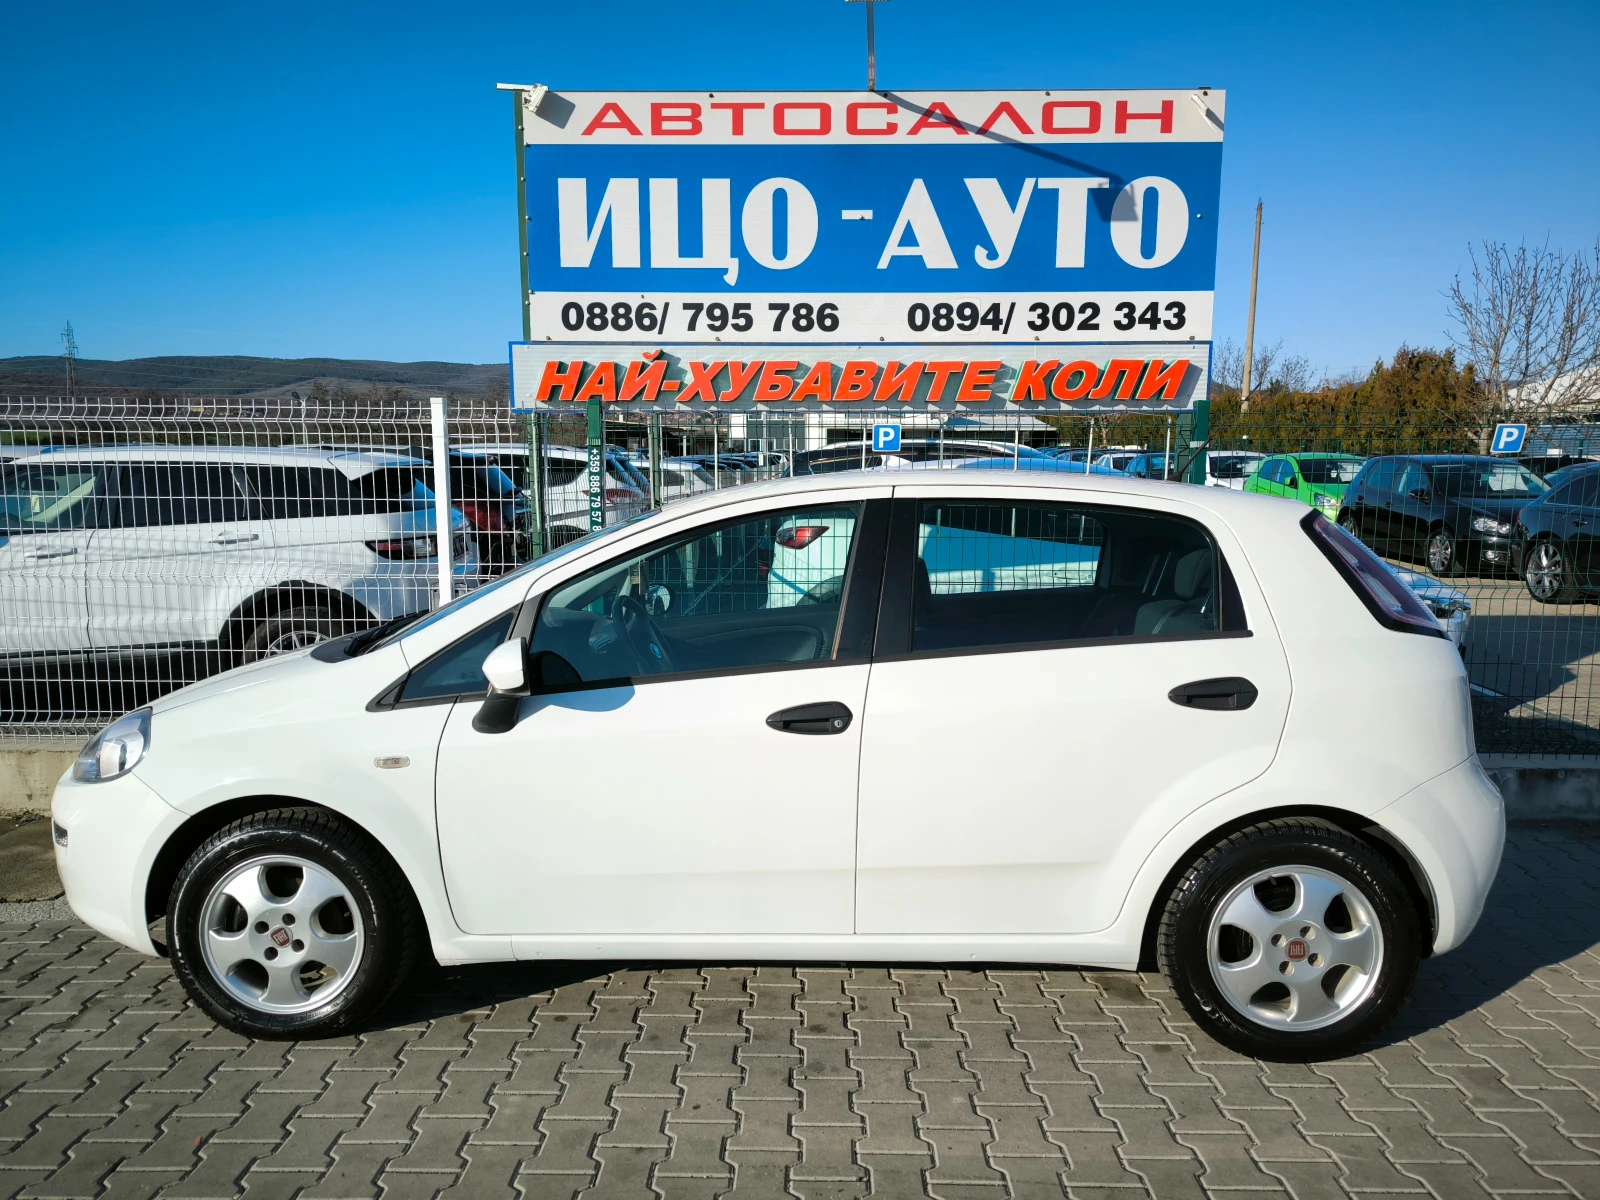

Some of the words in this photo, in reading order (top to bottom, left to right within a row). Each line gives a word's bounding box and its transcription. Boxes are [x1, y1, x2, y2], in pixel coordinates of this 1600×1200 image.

[581, 99, 1175, 138] АВТОСАЛОН
[561, 301, 670, 335] 0886/
[683, 302, 754, 332] 795
[768, 302, 840, 332] 786
[907, 301, 1016, 335] 0894/
[1027, 301, 1101, 332] 302
[1113, 301, 1187, 332] 343
[535, 349, 1003, 402] НАЙ-ХУБАВИТЕ
[1009, 358, 1191, 402] КОЛИ
[878, 427, 895, 448] P
[1498, 427, 1519, 449] P
[589, 448, 600, 472] +359
[590, 475, 600, 493] 886
[591, 495, 601, 508] 79
[591, 510, 602, 523] 57
[273, 929, 289, 945] FIAT
[1289, 944, 1304, 956] FIAT
